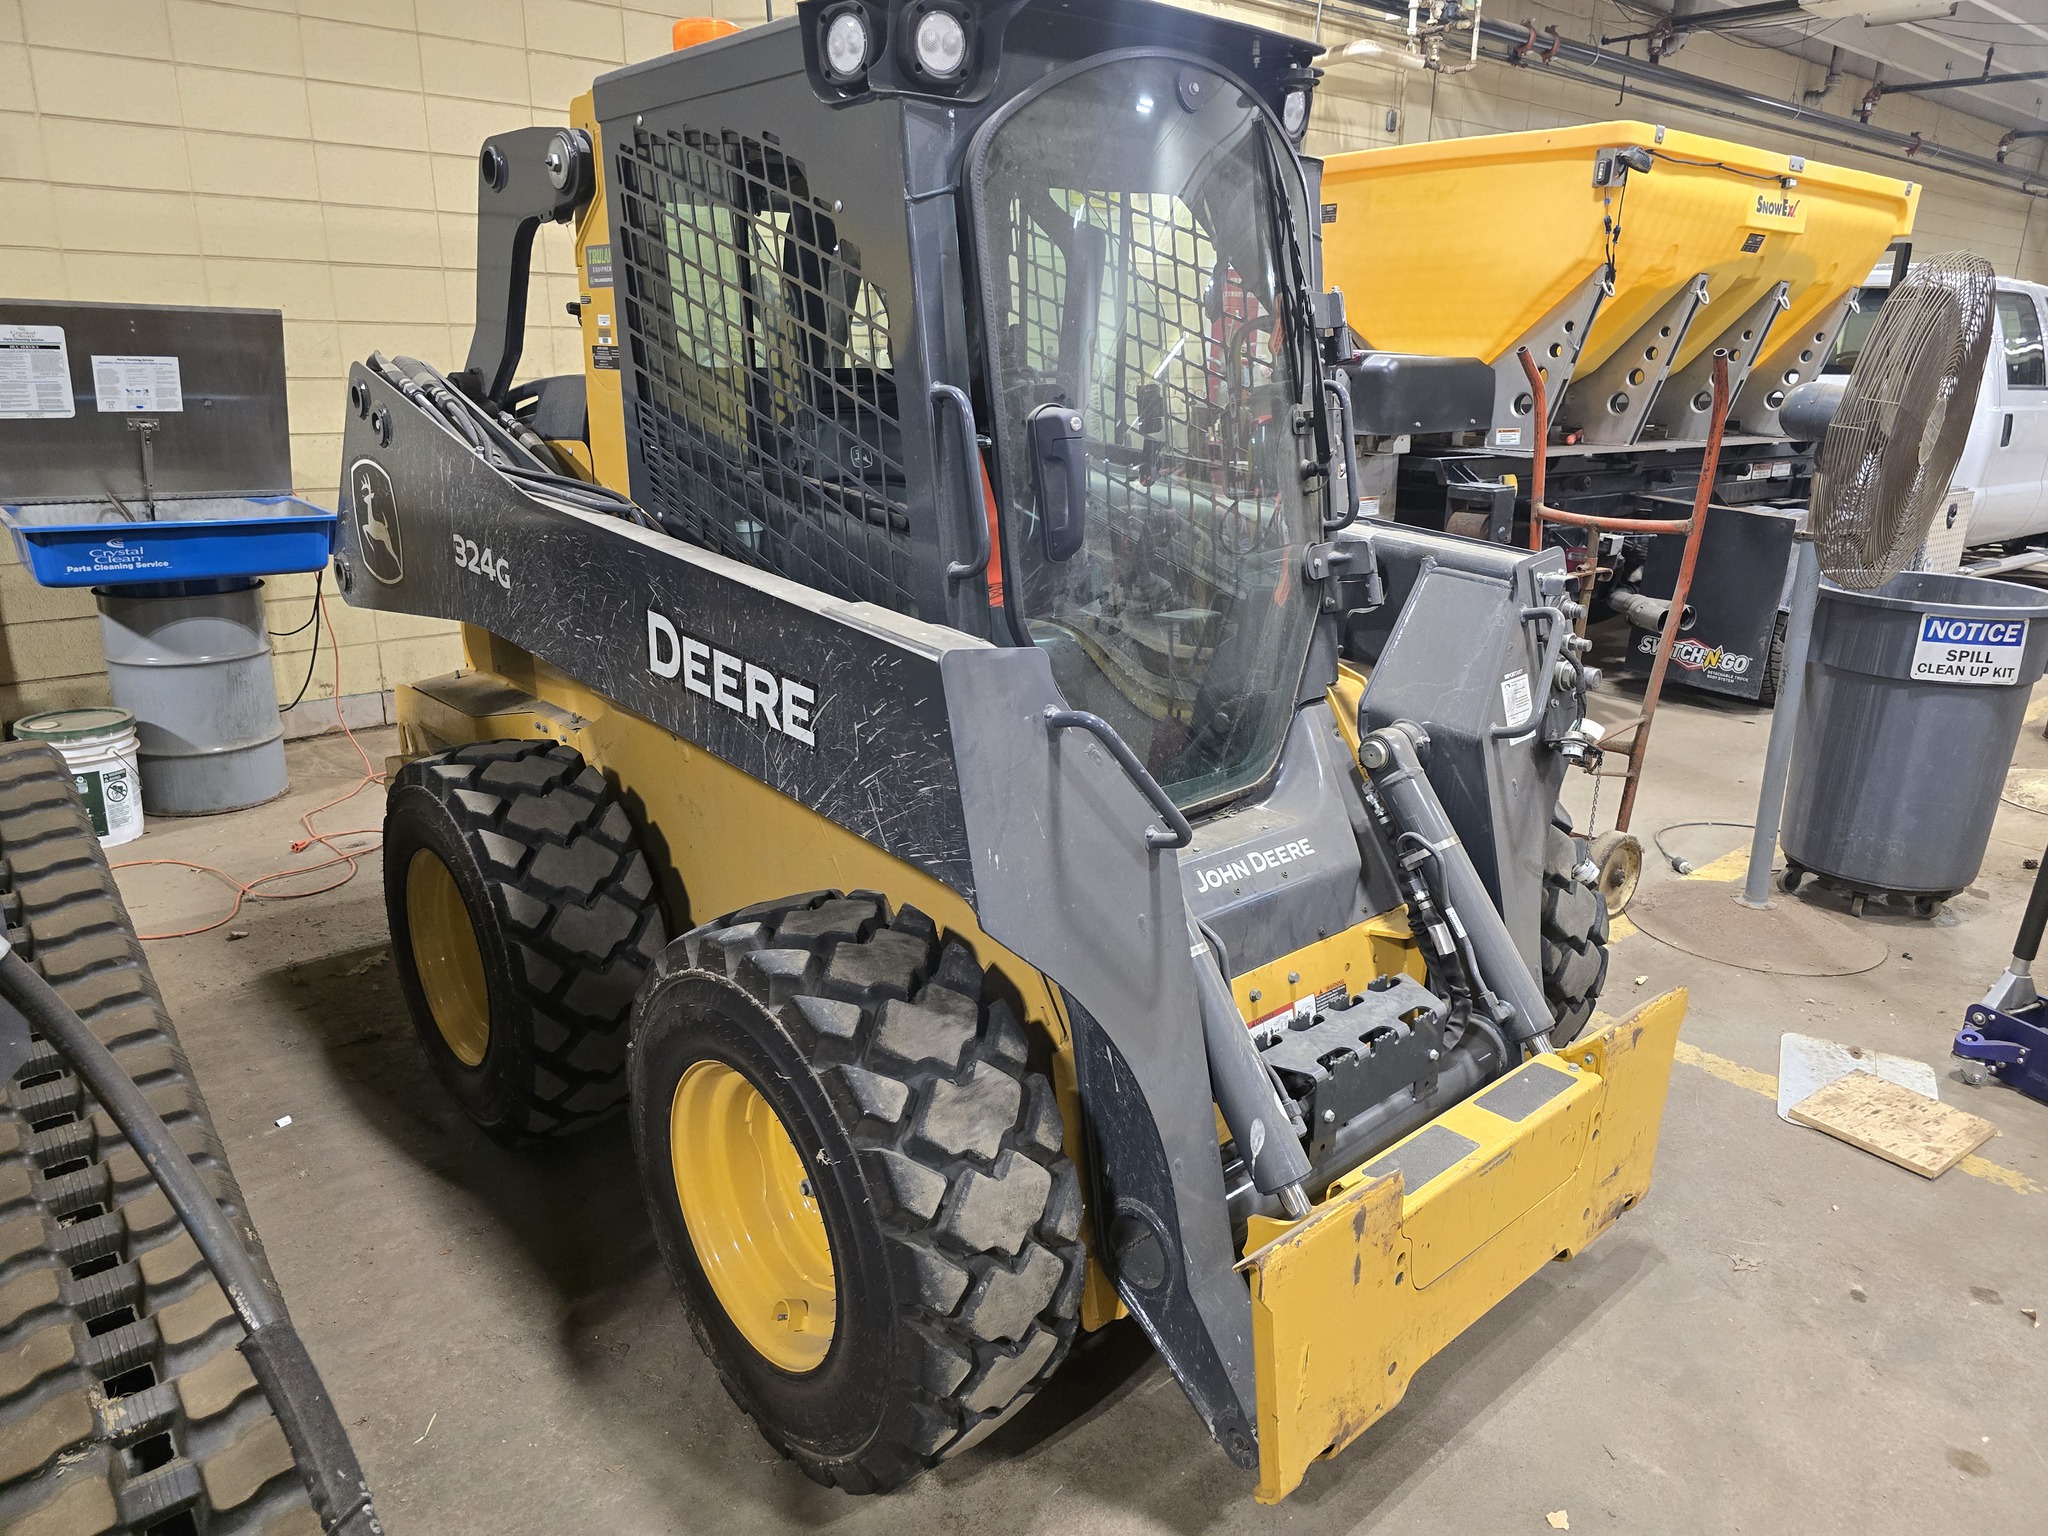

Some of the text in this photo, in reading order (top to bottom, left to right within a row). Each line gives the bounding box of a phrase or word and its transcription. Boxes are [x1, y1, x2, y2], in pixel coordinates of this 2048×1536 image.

[89, 546, 144, 559] Crystal
[94, 556, 142, 564] Clean
[453, 533, 511, 588] 324G
[66, 560, 169, 573] Parts Cleaning Service
[1927, 620, 2022, 643] NOTICE
[1945, 649, 1994, 664] SPILL
[647, 609, 816, 747] DEERE
[1917, 662, 2015, 678] CLEAN UP KIT
[1196, 838, 1316, 894] JOHN DEERE
